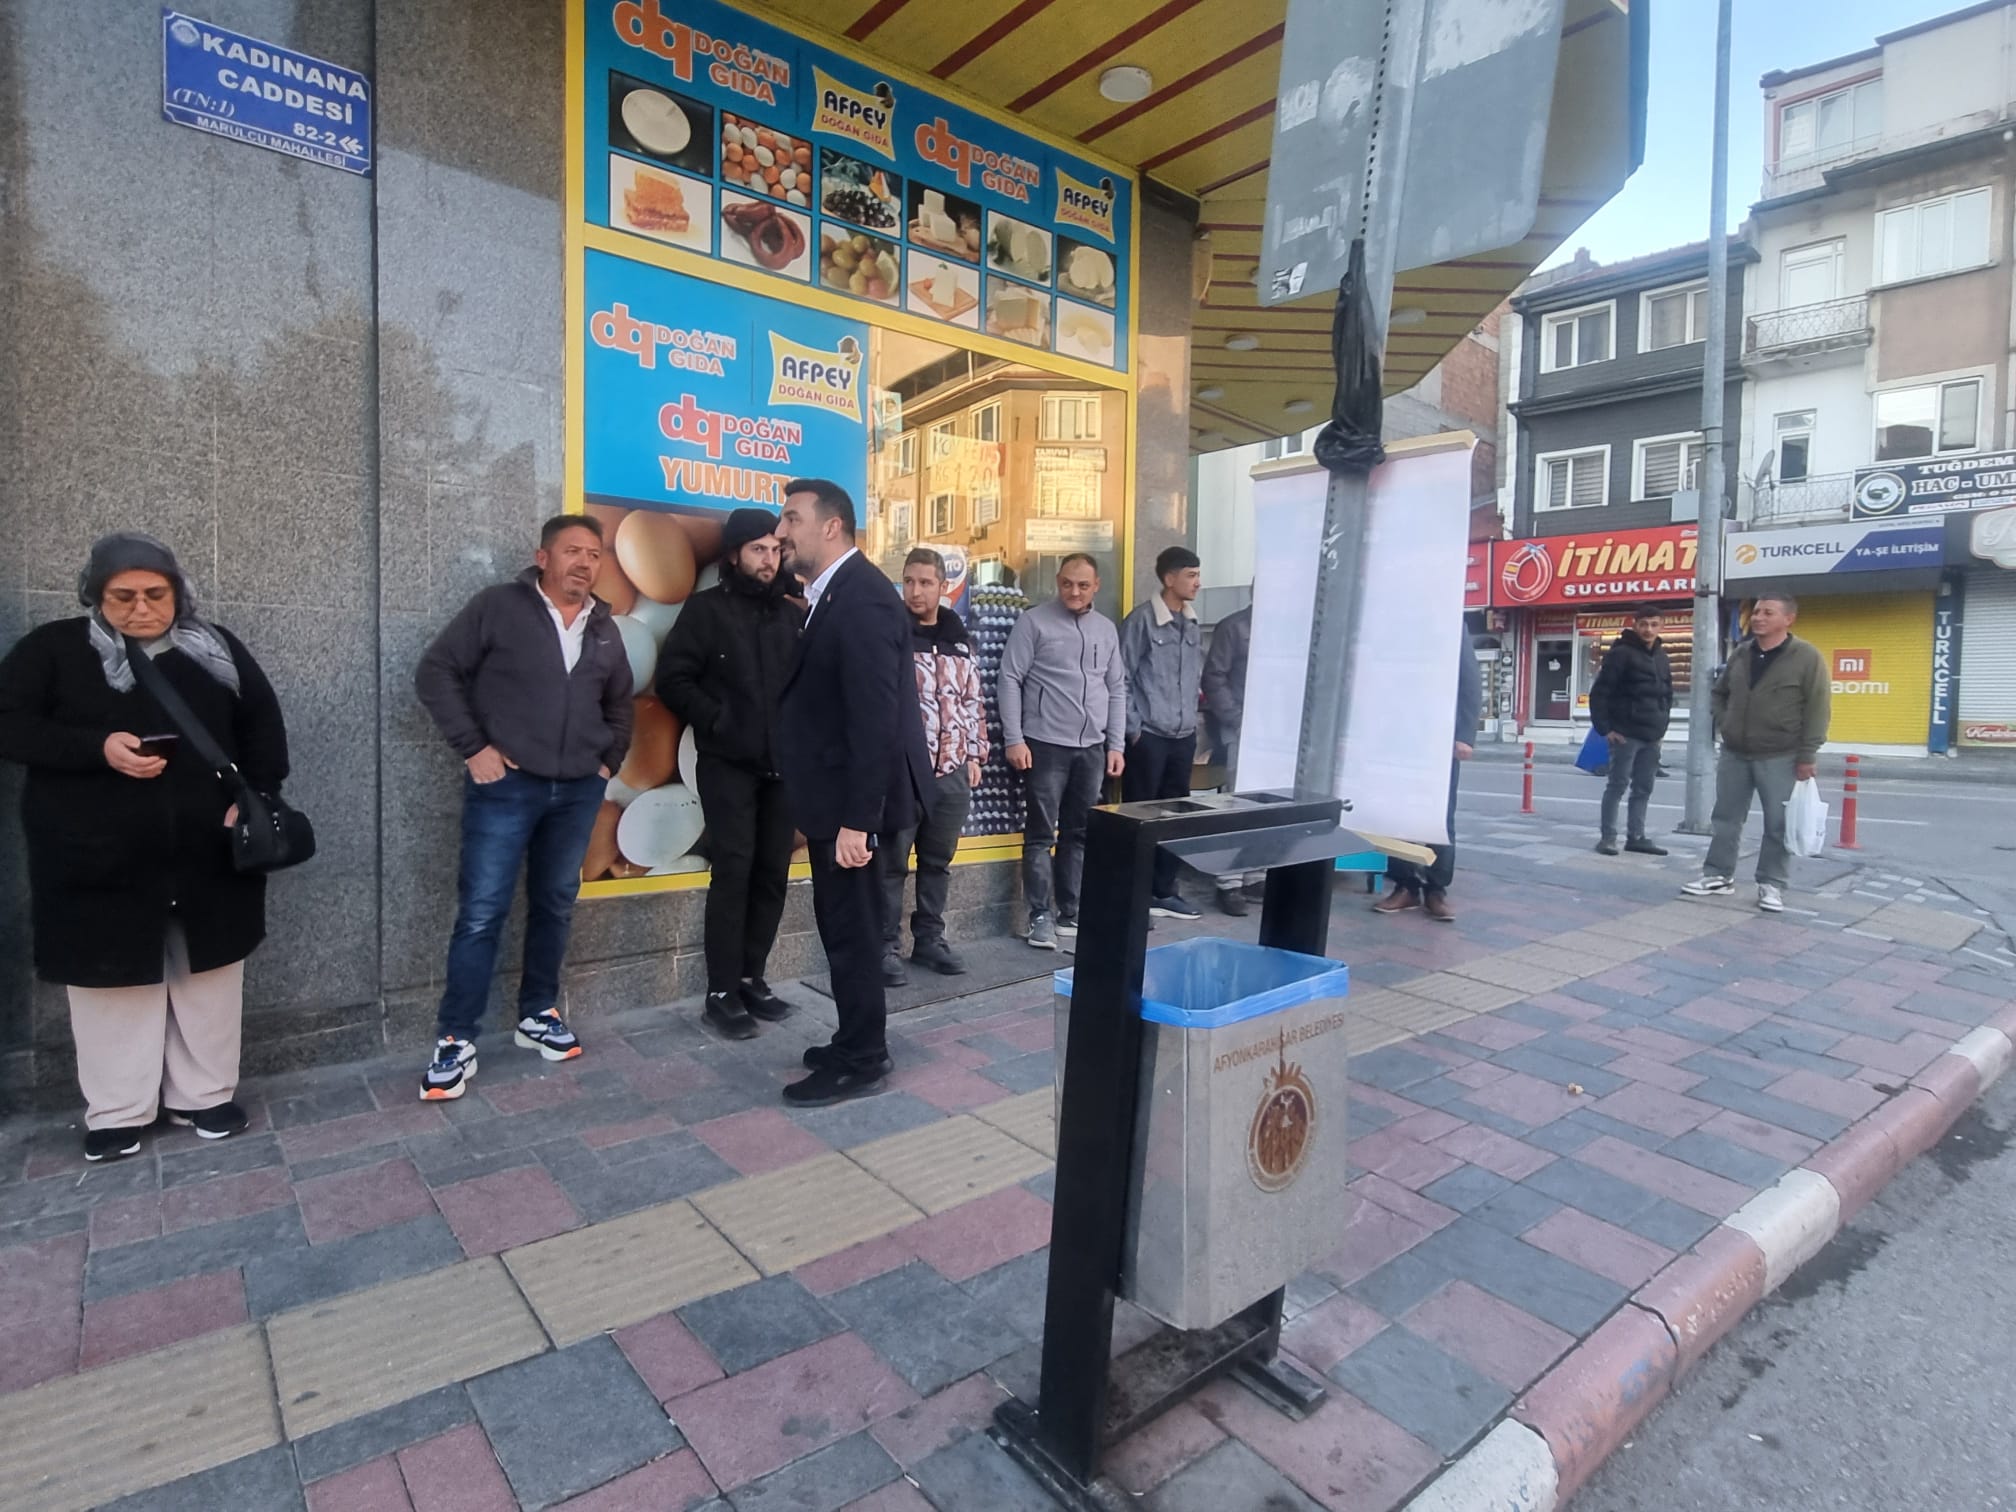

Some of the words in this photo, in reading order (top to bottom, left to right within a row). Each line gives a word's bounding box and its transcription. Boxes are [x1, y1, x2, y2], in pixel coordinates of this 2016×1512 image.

[203, 32, 367, 101] KADINANA
[694, 31, 790, 88] DOĞAN
[218, 69, 352, 125] CADDESİ
[709, 63, 776, 106] GIDA
[824, 90, 886, 130] AFPEY
[197, 116, 267, 144] MARULCU
[270, 136, 346, 167] MAHALLESİ
[293, 122, 337, 147] 82-2
[971, 145, 1039, 187] DOĞAN
[981, 170, 1029, 203] GIDA
[1064, 188, 1109, 217] AFPEY
[656, 325, 736, 360] DOĞAN
[669, 350, 724, 377] GIDA
[782, 356, 851, 390] AFPEY
[778, 384, 822, 402] DOĞAN
[826, 394, 855, 409] GIDA
[723, 415, 802, 446] DOĞAN
[735, 440, 790, 463] GIDA
[1918, 456, 2015, 474] TUĞDEM
[659, 457, 790, 505] YUMURT
[1912, 476, 1959, 496] HAC
[1557, 539, 1698, 578] İTİMAT
[1760, 542, 1845, 559] TURKCELL
[1564, 577, 1697, 596] SUCUKLARI
[1932, 611, 1952, 724] TURKCELL
[1830, 681, 1889, 694] aomi
